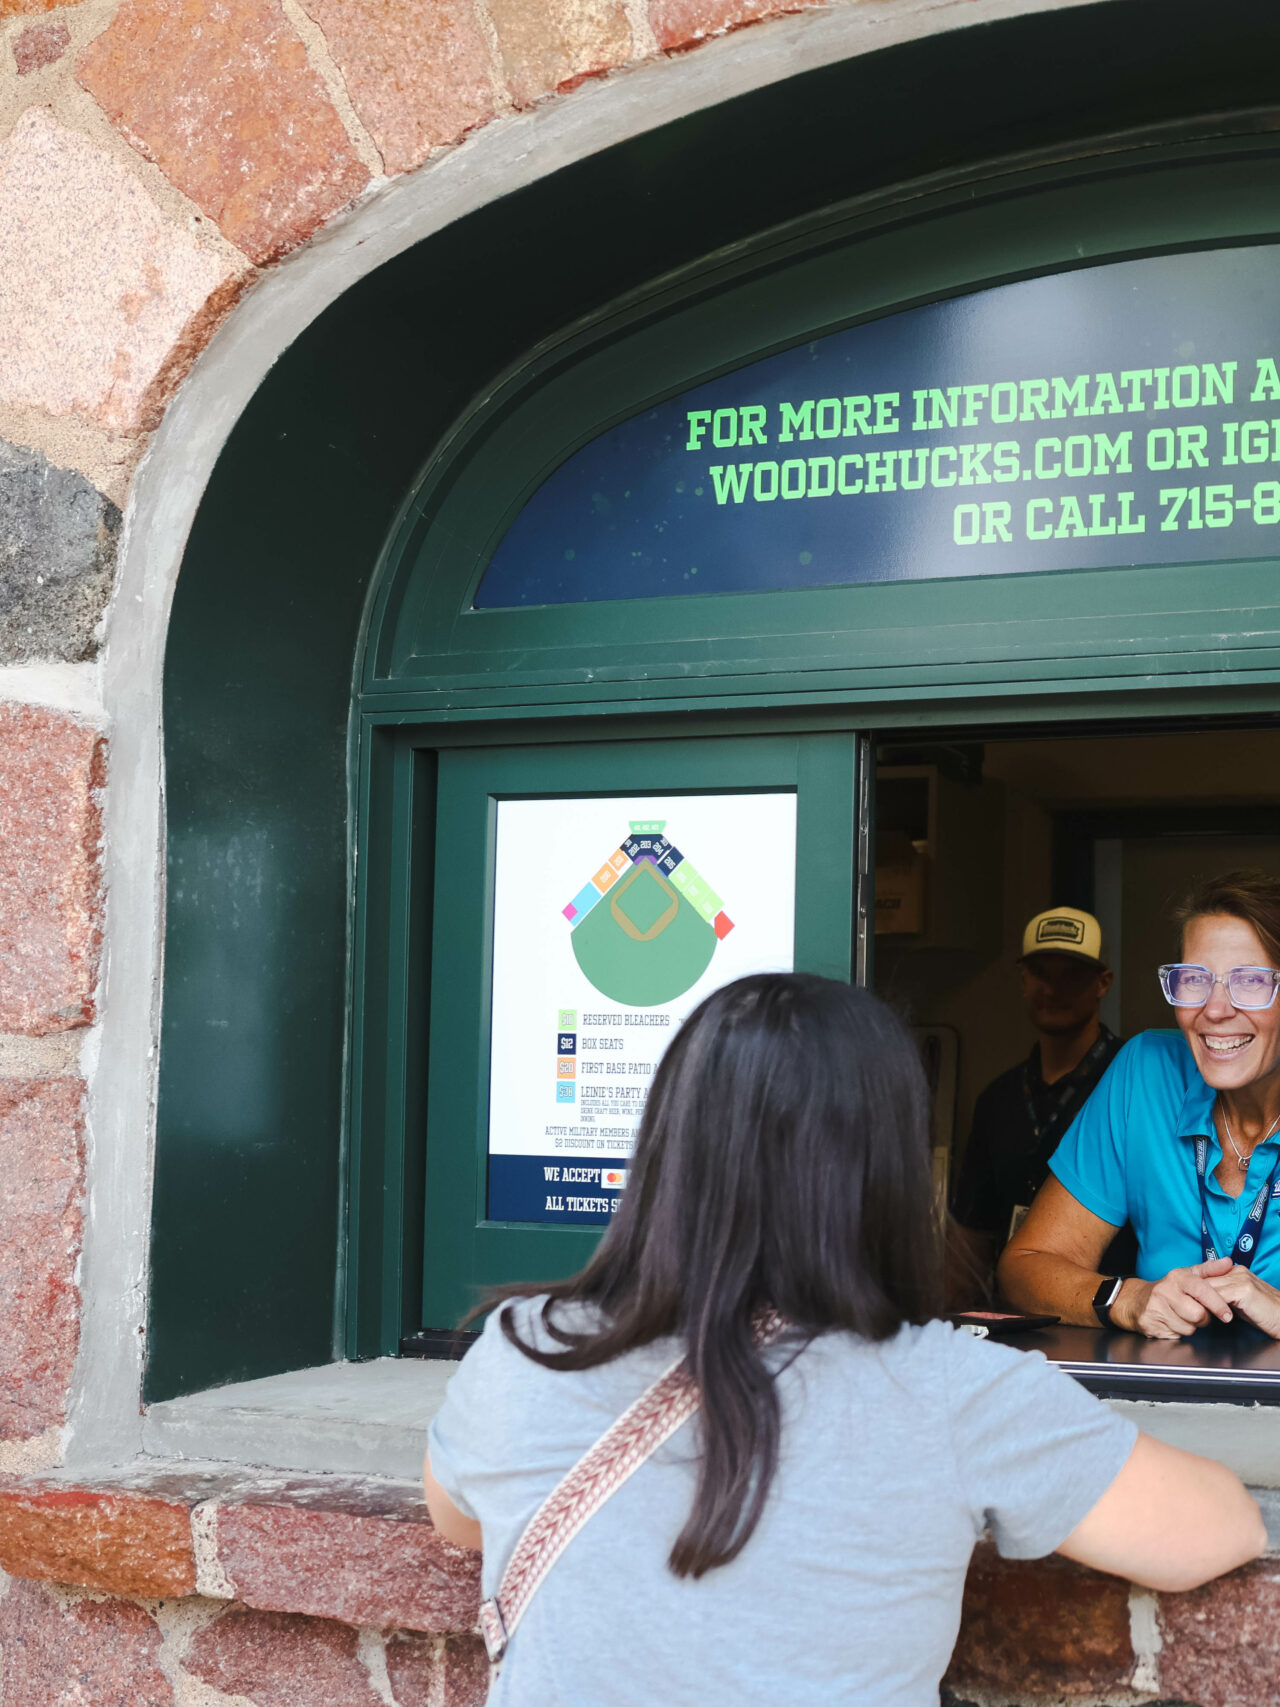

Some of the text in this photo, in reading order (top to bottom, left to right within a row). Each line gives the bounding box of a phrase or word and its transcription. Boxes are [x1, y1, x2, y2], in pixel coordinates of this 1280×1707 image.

[686, 405, 768, 451] FOR
[778, 392, 900, 443] MORE
[911, 361, 1238, 431] INFORMATION
[709, 432, 1133, 505] WOODCHUCKS.COM
[1146, 425, 1210, 471] OR
[953, 503, 1013, 545] OR
[1026, 492, 1146, 540] CALL
[582, 1013, 622, 1026] RESERVED
[624, 1014, 670, 1026] BLEACHERS
[582, 1038, 624, 1050] BOX SEATS
[581, 1062, 604, 1073] FIRST
[606, 1062, 626, 1074] BASE
[628, 1063, 651, 1074] PATIO
[581, 1086, 614, 1098] LEINIE'S
[615, 1086, 641, 1098] PARTY
[545, 1126, 567, 1135] ACTIVE
[569, 1126, 598, 1136] MILITARY
[600, 1127, 629, 1137] MEMBERS
[564, 1139, 595, 1148] DISCOUNT
[597, 1140, 605, 1149] ON
[543, 1166, 601, 1183] WE ACCEPT
[545, 1195, 565, 1210] ALL
[566, 1196, 609, 1212] TICKETS
